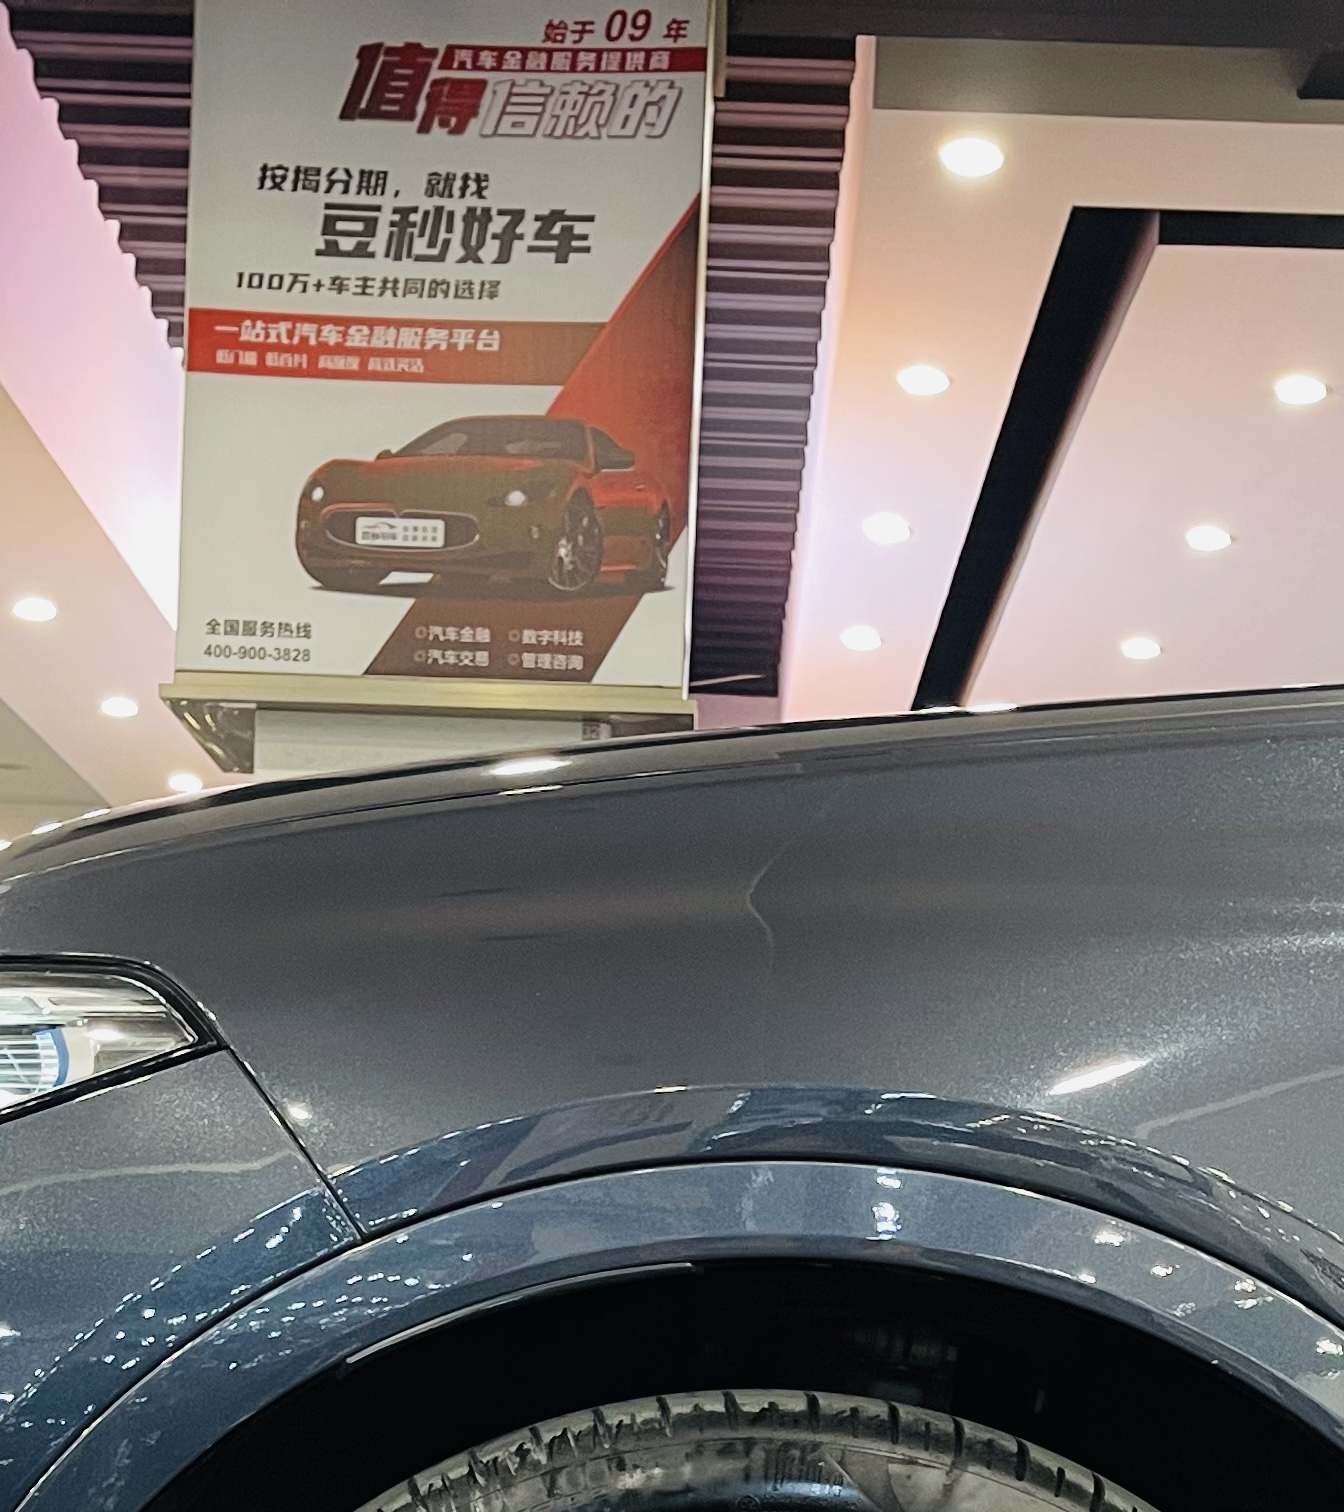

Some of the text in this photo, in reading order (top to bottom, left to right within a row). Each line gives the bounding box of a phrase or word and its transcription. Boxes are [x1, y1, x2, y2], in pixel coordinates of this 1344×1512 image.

[542, 9, 690, 43] 始于 09 年
[452, 49, 671, 71] 汽车金融服务提供商
[339, 41, 683, 139] 值得信赖的
[314, 202, 596, 264] 豆秒好车
[236, 271, 502, 300] 100万+车主共同的选择
[214, 319, 501, 351] 一站式汽车金融服务平台
[205, 618, 313, 640] 全国服务热线
[203, 644, 312, 664] 400-900-3828
